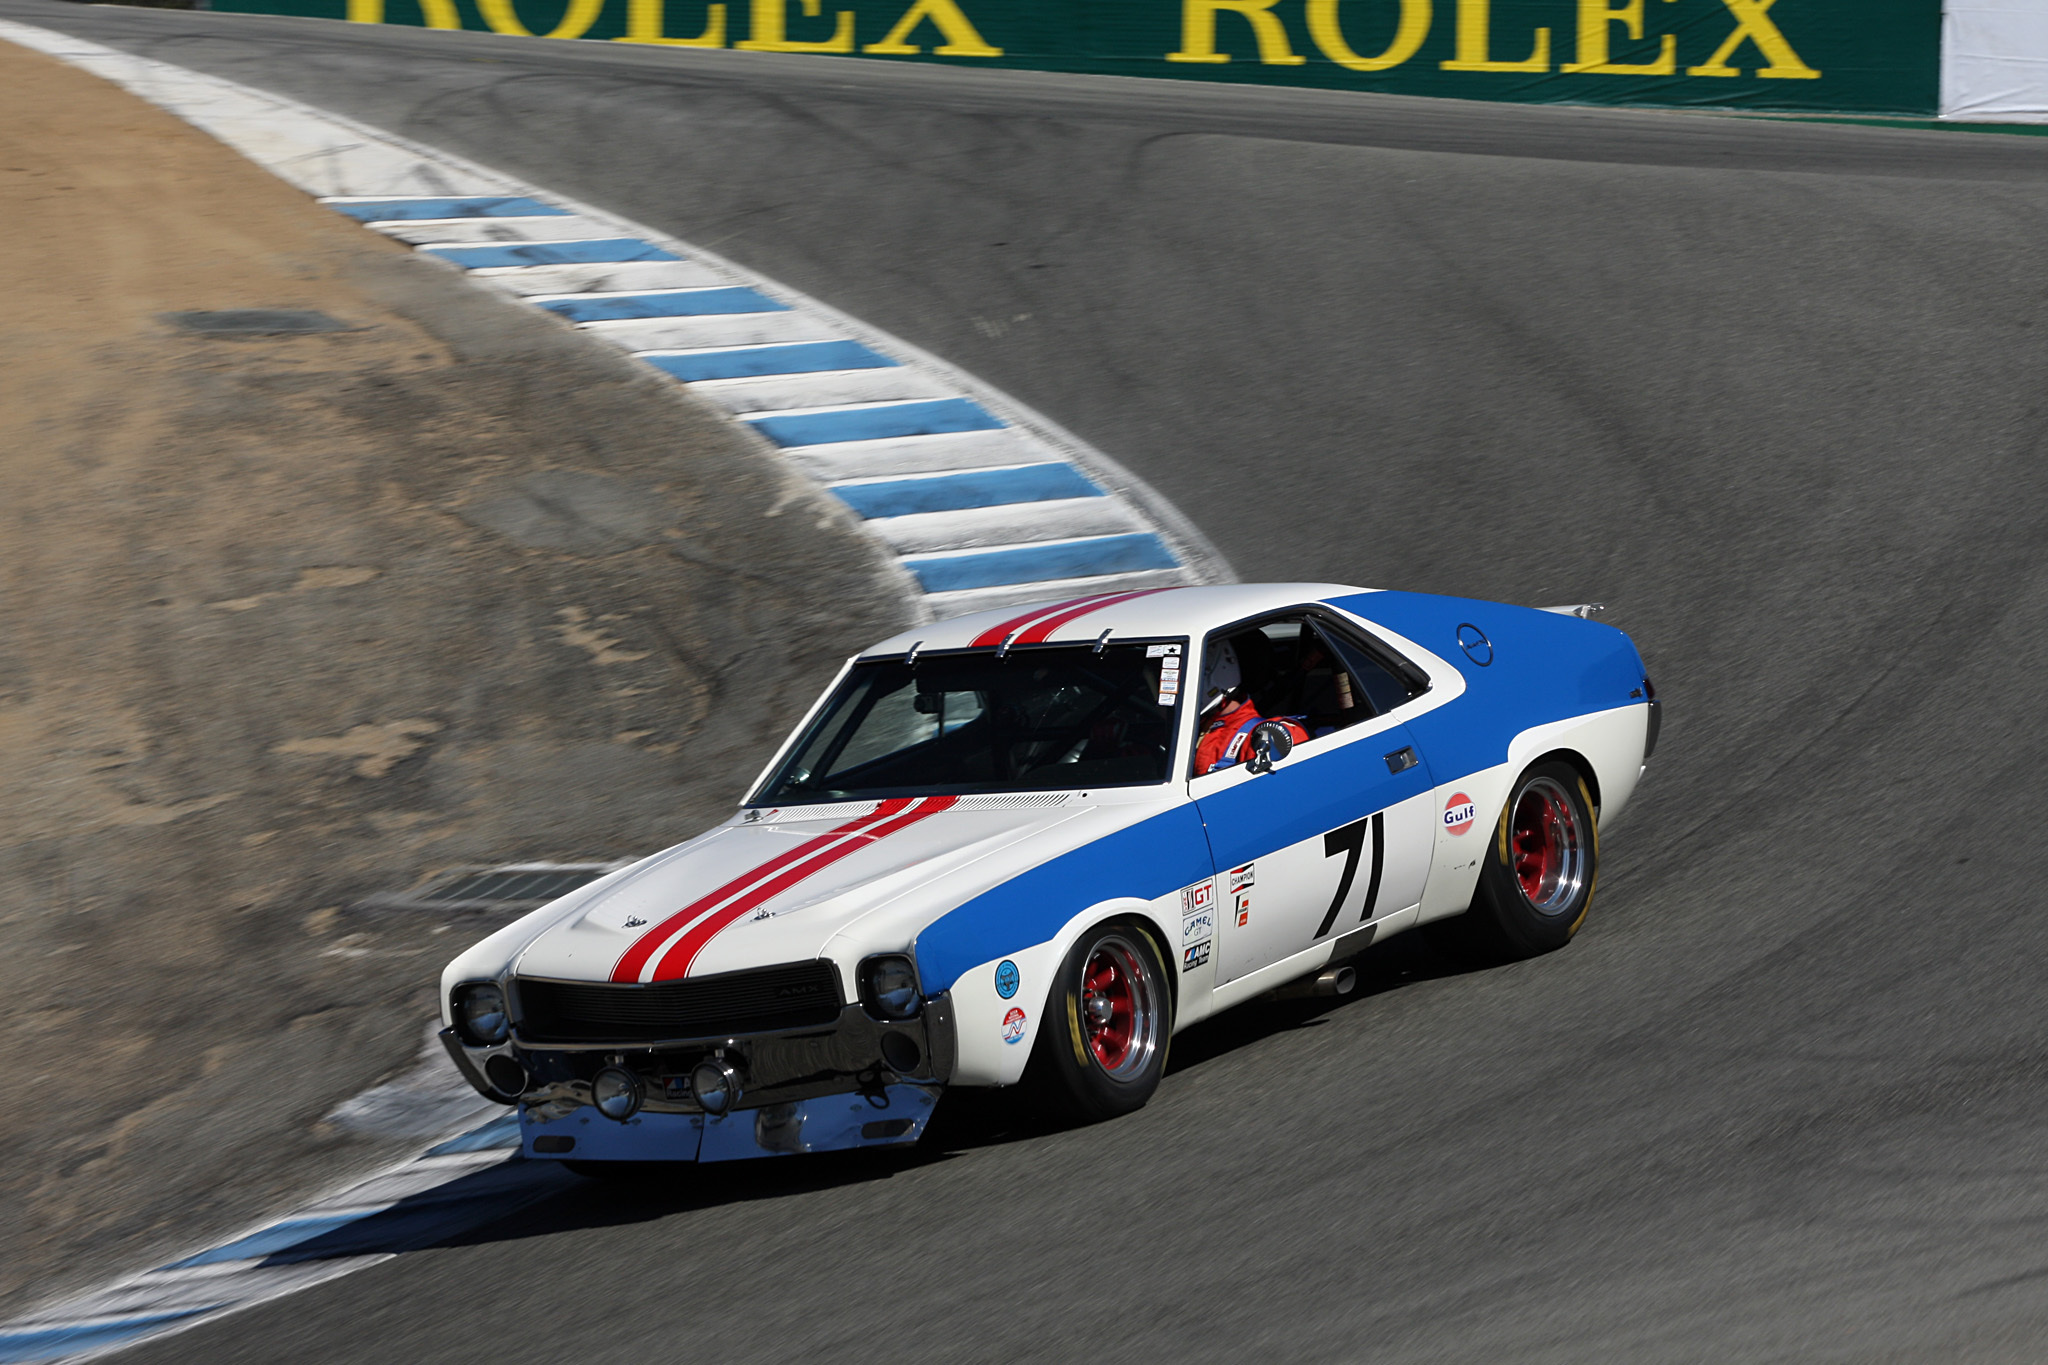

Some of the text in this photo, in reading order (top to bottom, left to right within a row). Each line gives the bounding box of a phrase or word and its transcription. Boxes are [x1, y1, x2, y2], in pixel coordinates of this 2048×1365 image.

[1165, 0, 1822, 79] ROLEX
[1443, 805, 1475, 824] Gulf
[1231, 872, 1253, 886] CHAMPION
[1312, 811, 1385, 941] 71
[1195, 884, 1212, 905] GT
[1184, 916, 1212, 936] CAMEL
[1194, 927, 1202, 937] GT
[1195, 943, 1210, 958] AMC
